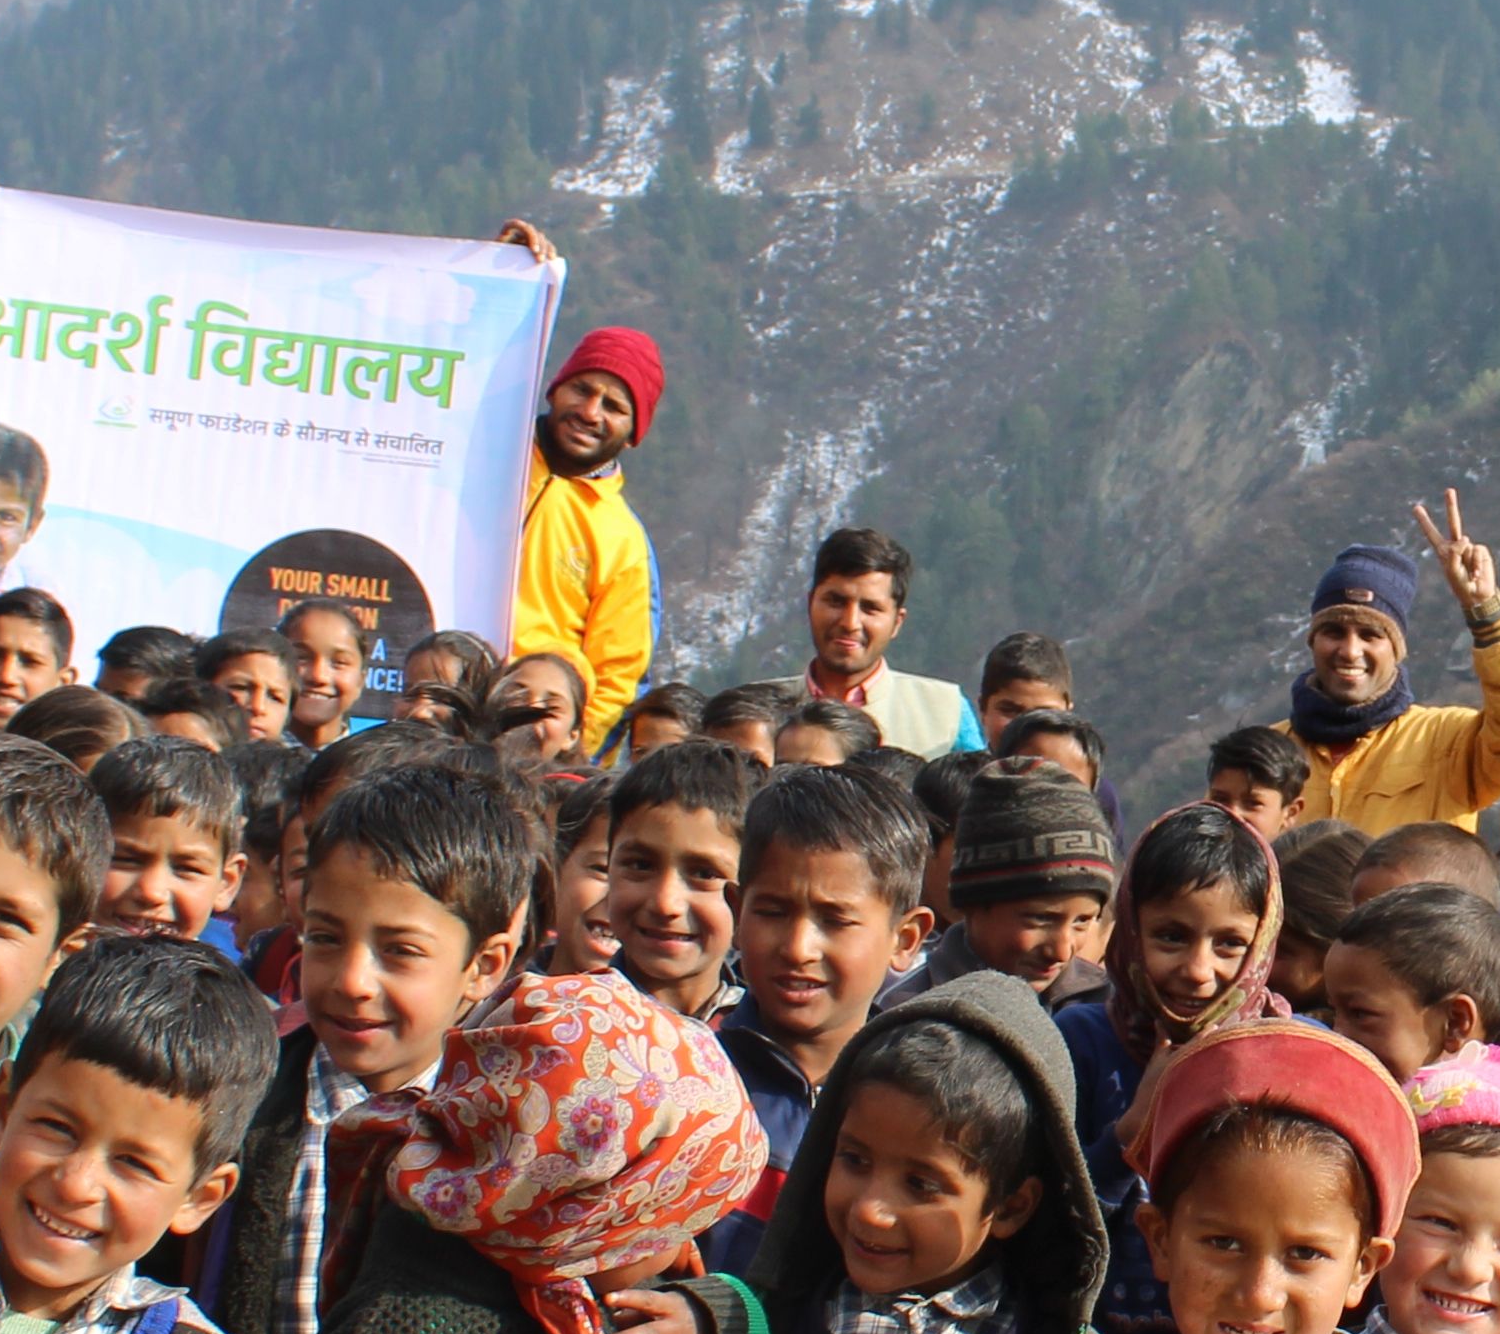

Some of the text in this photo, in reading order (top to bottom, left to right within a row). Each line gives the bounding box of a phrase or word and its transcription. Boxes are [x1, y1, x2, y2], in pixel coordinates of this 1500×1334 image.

[185, 299, 466, 410] विद्यालय
[269, 566, 393, 603] YOUR SMALL
[371, 637, 388, 662] A
